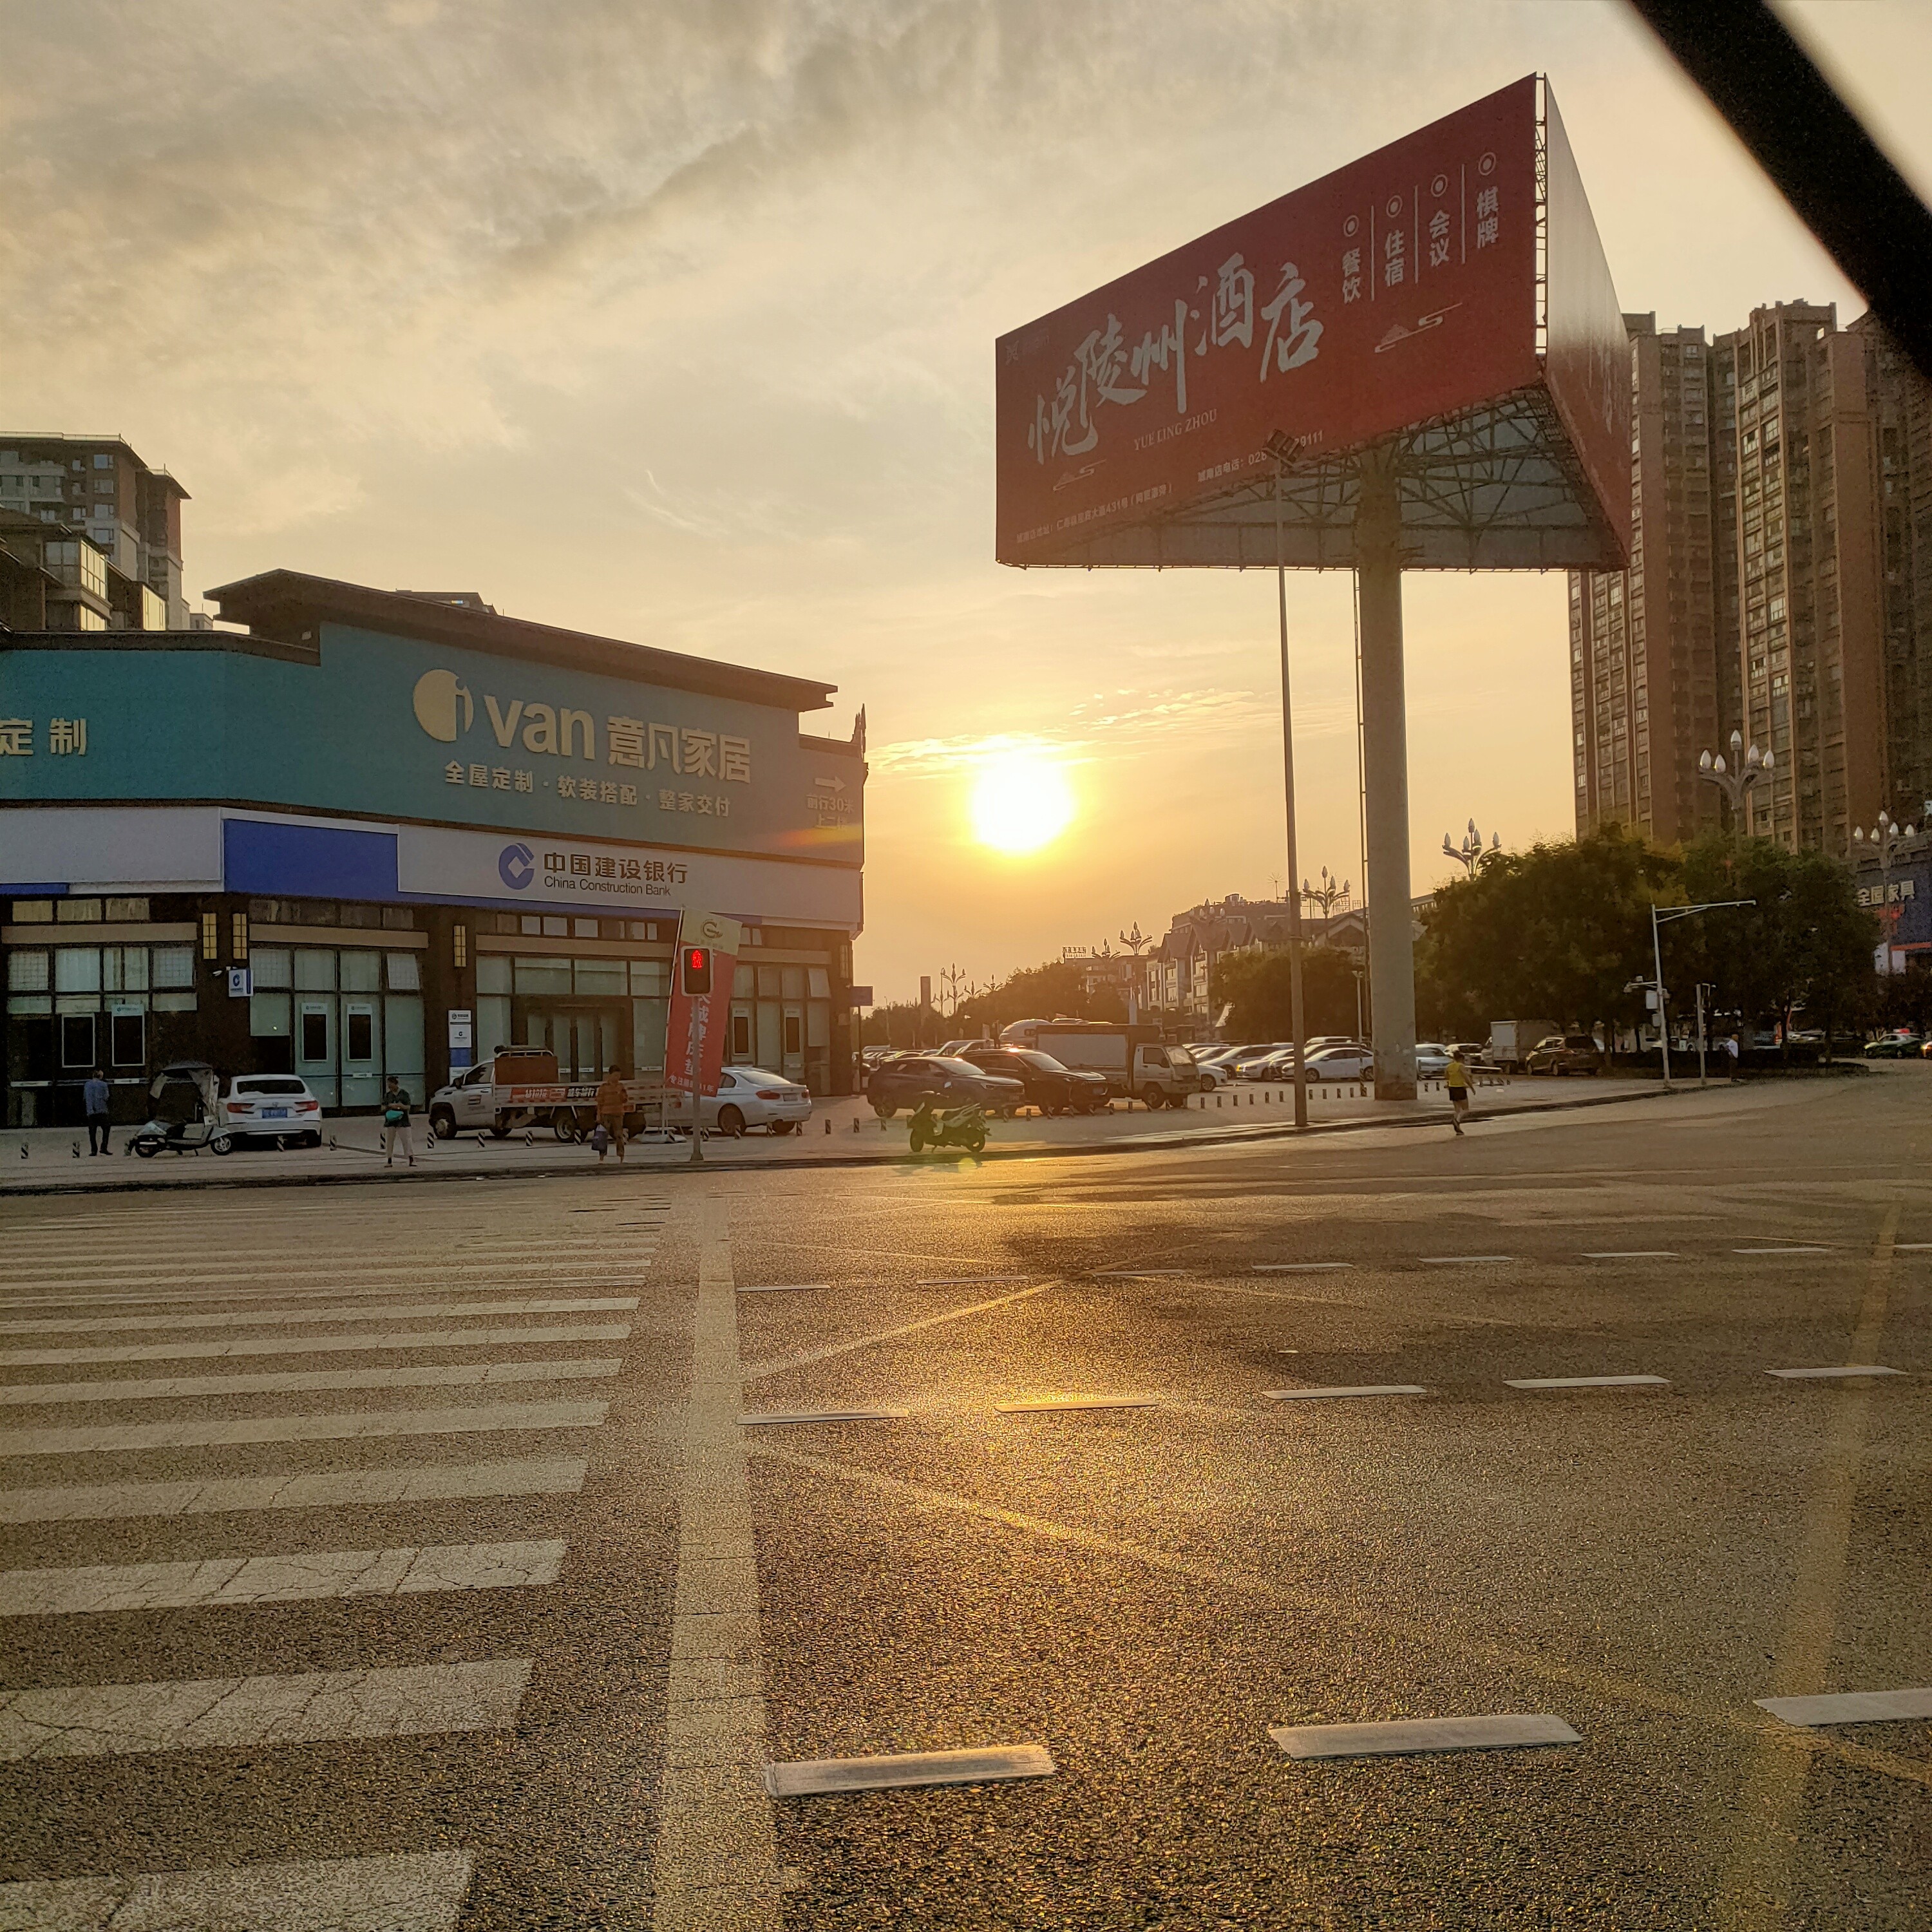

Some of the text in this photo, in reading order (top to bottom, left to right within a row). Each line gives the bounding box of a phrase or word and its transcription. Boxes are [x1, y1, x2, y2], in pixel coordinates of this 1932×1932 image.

[1428, 209, 1450, 267] 会议
[1476, 186, 1499, 249] 棋牌
[1342, 247, 1361, 305] 餐饮
[1385, 229, 1405, 287] 住宿
[1133, 408, 1218, 451] YUE LING ZHOU
[0, 717, 88, 757] 定制
[607, 715, 752, 784] 意凡家居
[444, 760, 732, 818] 全屋定制 软装搭配 整家交付
[806, 792, 855, 814] 前行30米
[544, 851, 688, 885] 中国建设银行
[544, 876, 672, 897] China Construction Bank
[1857, 880, 1915, 907] 全屋家具
